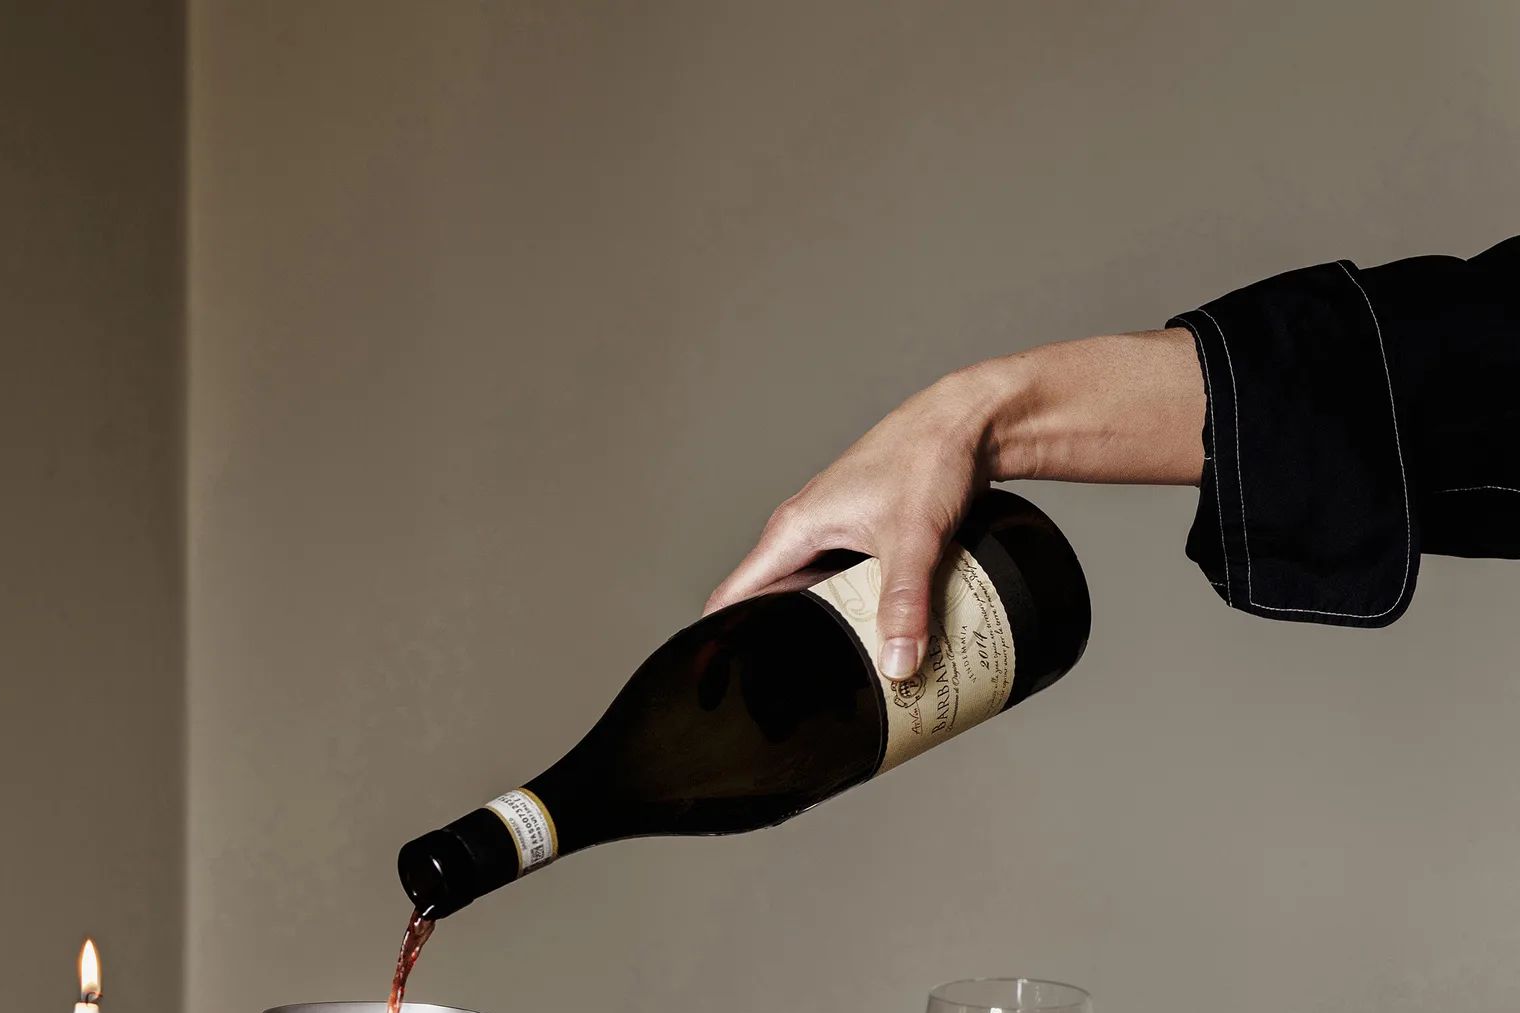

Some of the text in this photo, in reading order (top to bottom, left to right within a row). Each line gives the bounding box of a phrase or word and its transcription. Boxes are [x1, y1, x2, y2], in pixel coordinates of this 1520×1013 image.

[960, 624, 977, 684] VENDEMMIA
[972, 630, 990, 670] 2014
[929, 634, 950, 735] BARBARES
